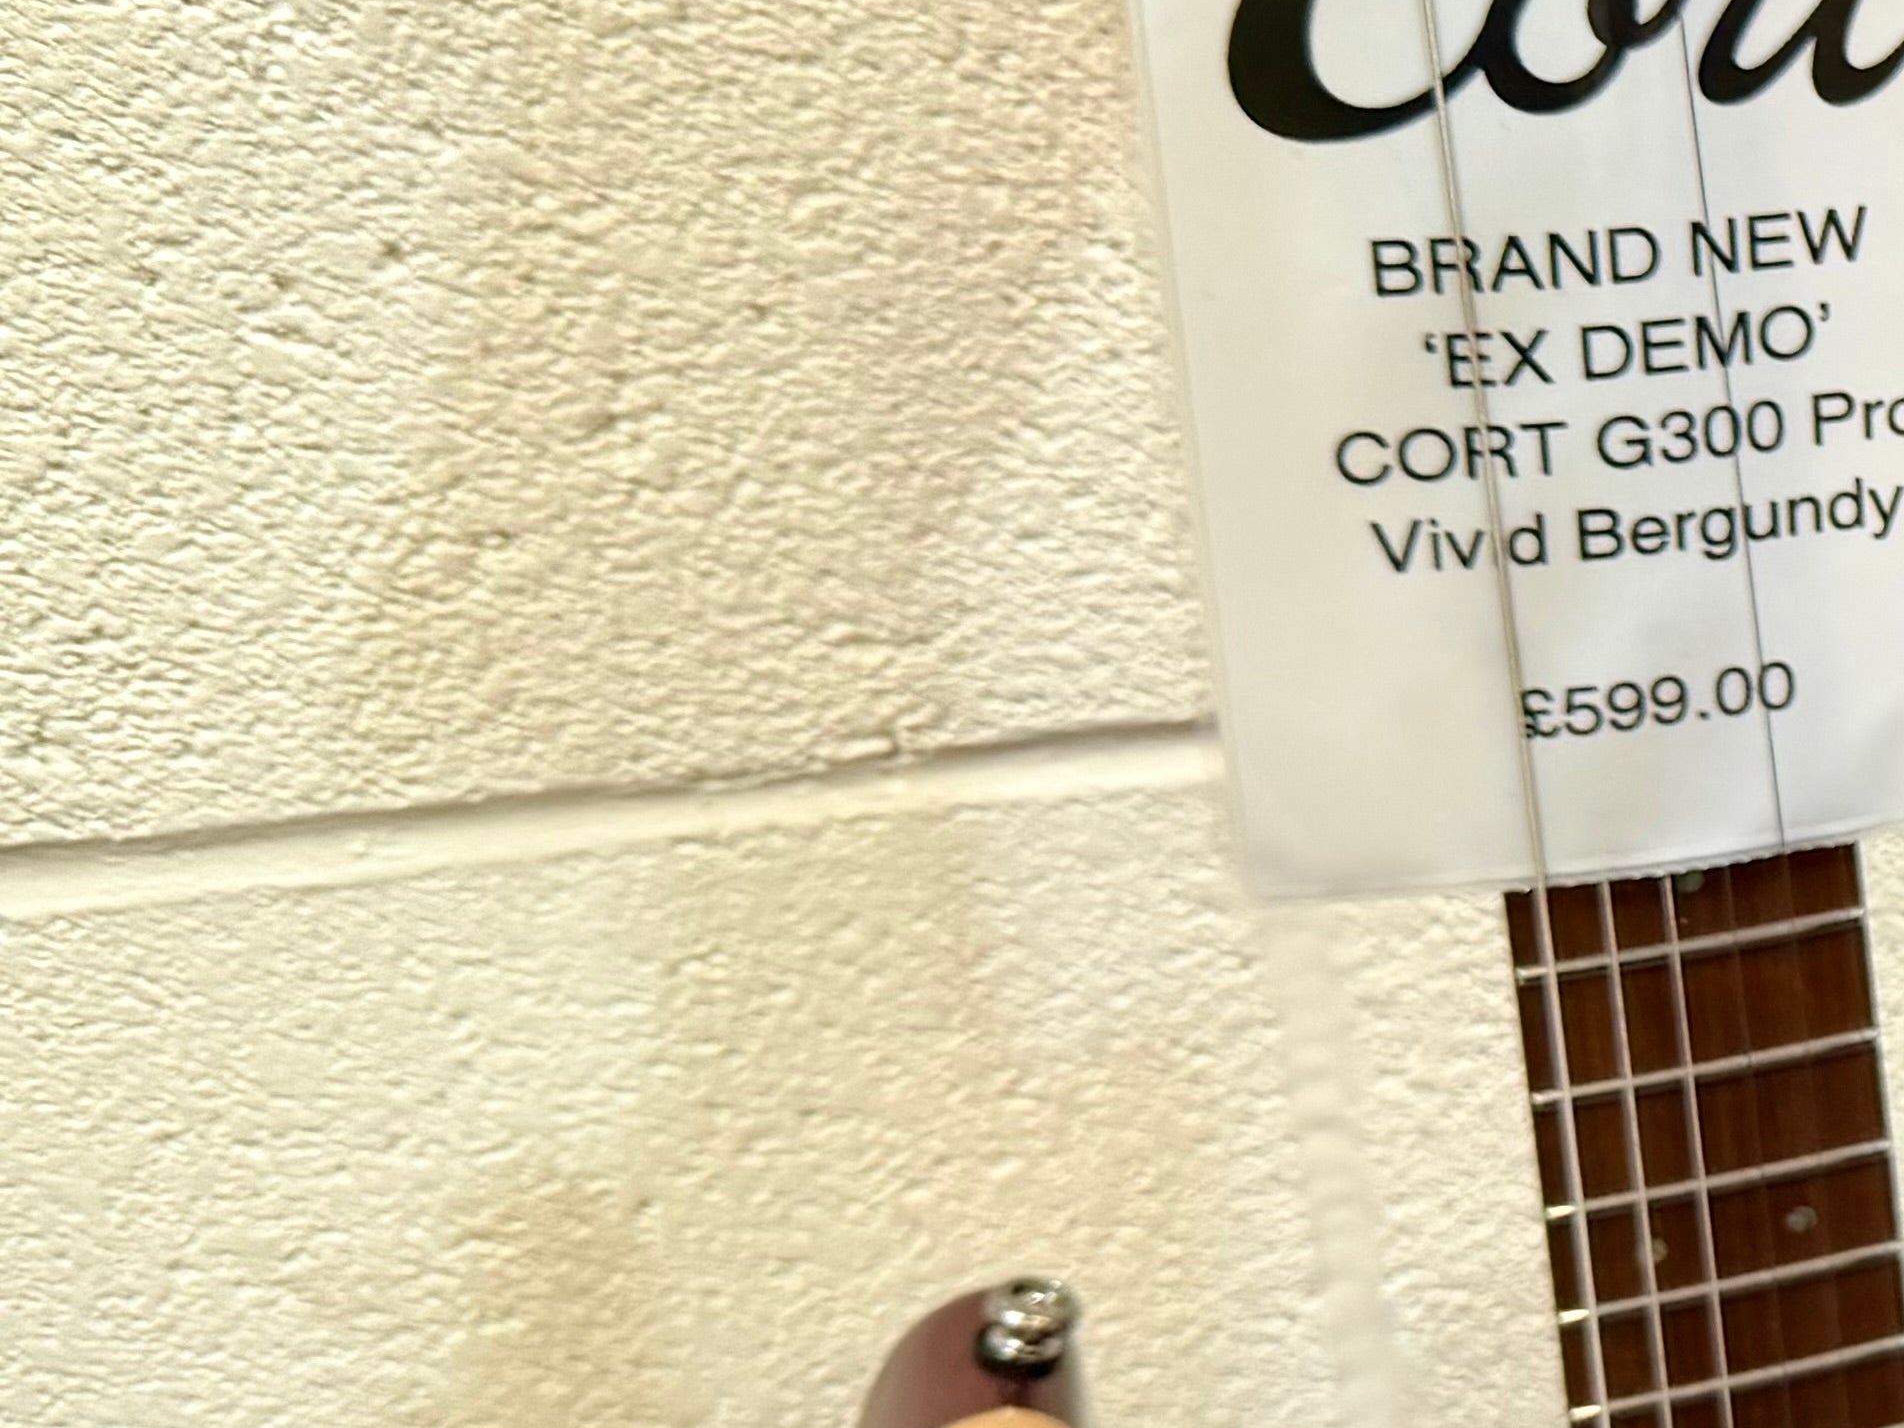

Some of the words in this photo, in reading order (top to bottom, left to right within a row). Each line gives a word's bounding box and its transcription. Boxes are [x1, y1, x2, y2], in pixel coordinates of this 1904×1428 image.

[1369, 225, 1662, 298] BRAND
[1690, 206, 1867, 276] NEW
[1334, 421, 1568, 486] CORT
[1596, 399, 1785, 469] G300
[1370, 512, 1549, 573] Vivd
[1576, 478, 1904, 562] Bergundy
[1520, 661, 1795, 738] £599.00
